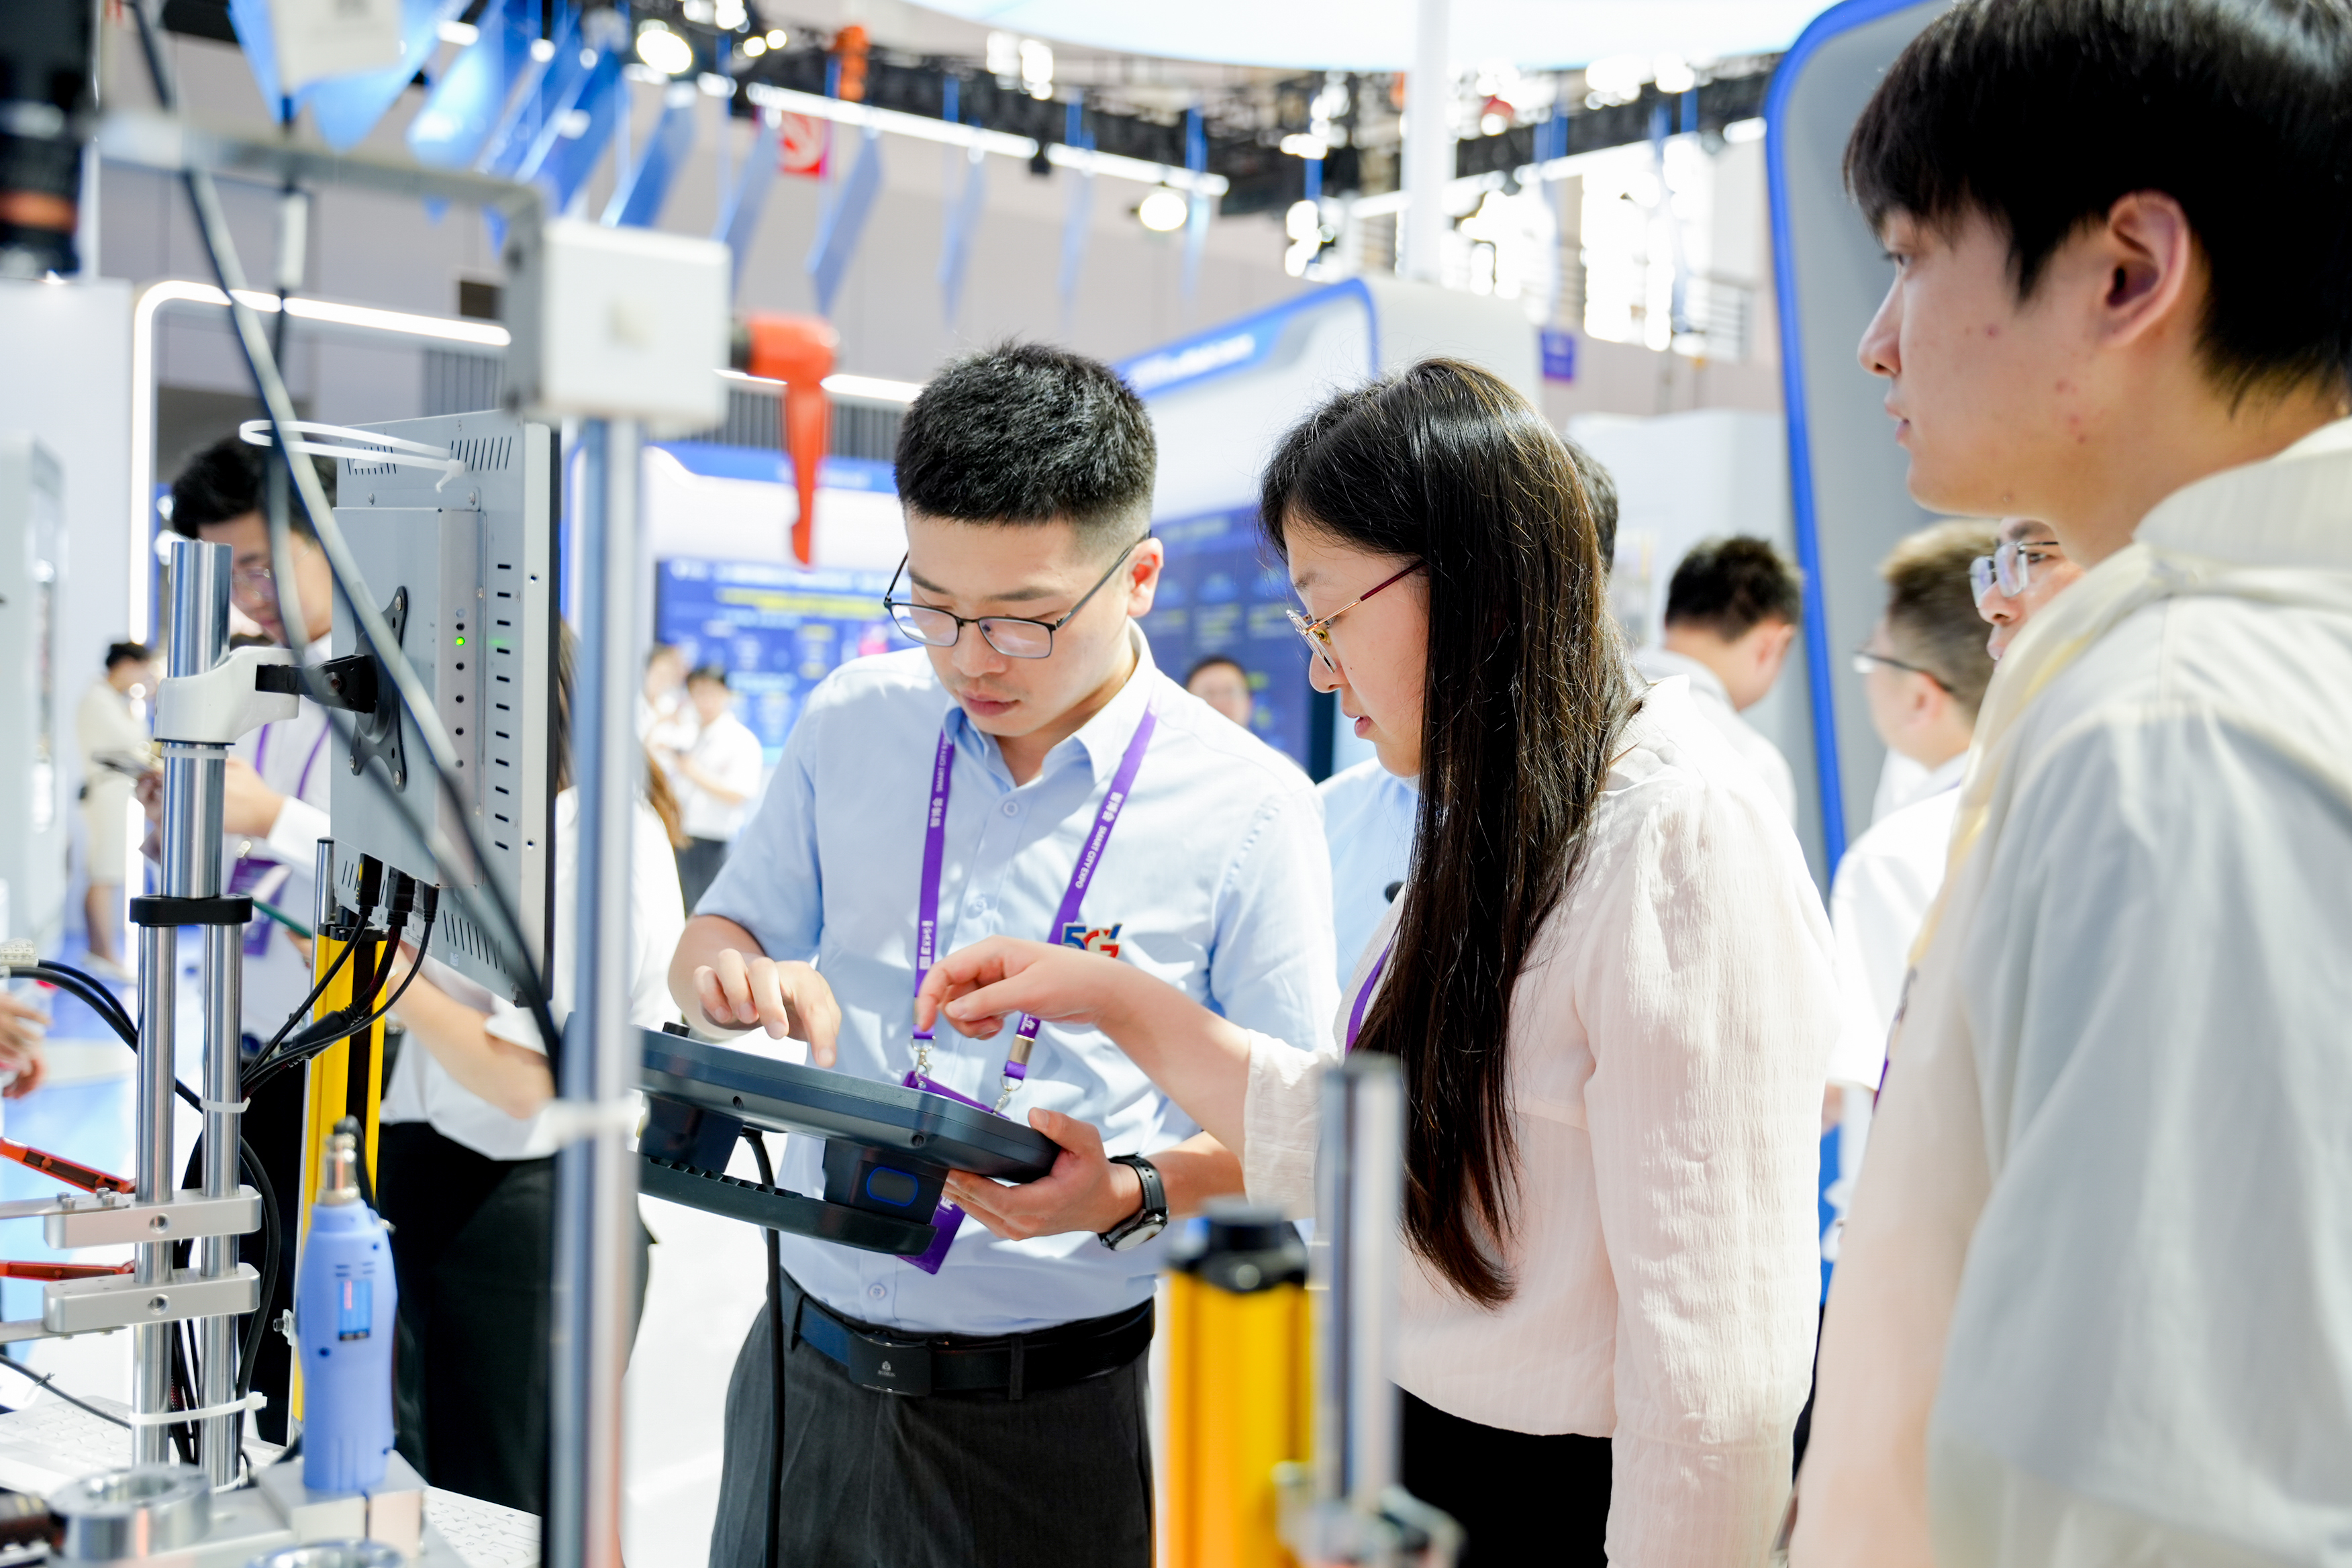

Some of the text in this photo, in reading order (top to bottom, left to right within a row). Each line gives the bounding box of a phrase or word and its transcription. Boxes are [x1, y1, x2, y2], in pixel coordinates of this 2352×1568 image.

[936, 767, 944, 792] SMART
[1075, 791, 1124, 889] 智博会 SMART CITY EXPO
